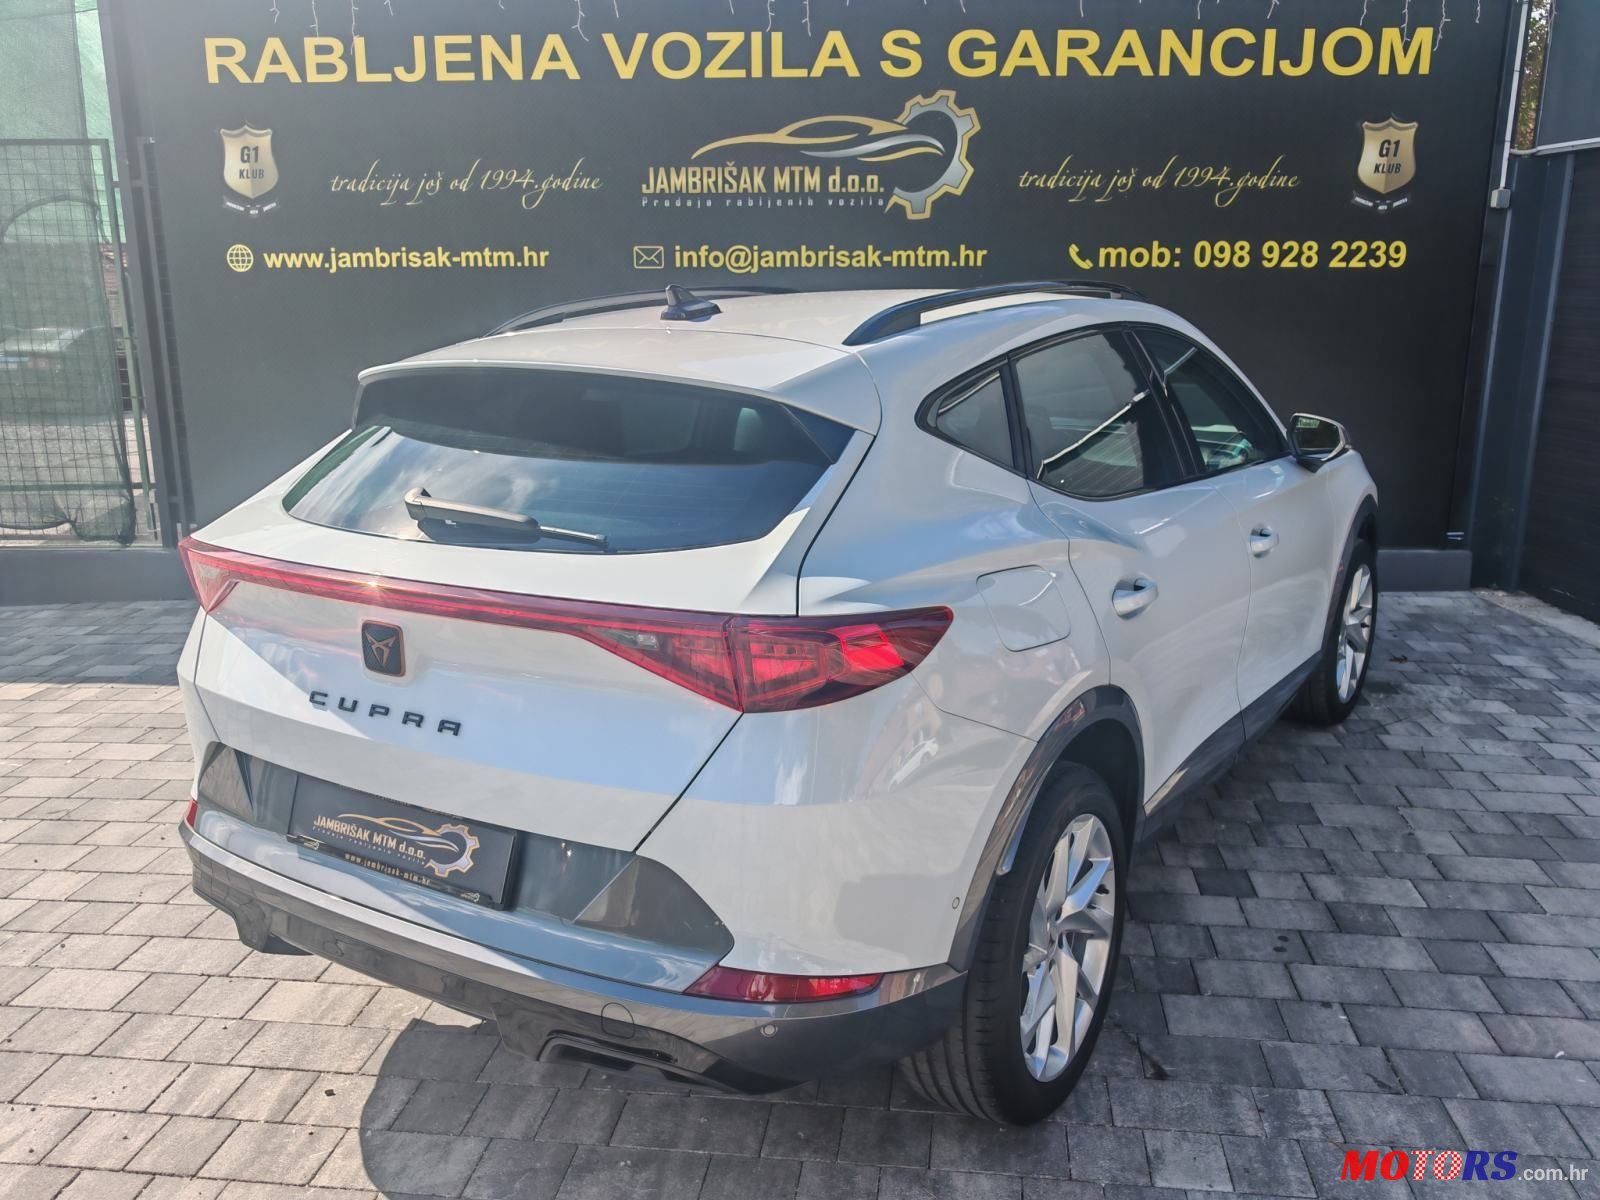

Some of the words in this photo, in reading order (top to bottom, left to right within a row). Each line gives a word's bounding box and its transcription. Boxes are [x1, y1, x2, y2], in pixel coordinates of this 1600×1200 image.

[204, 33, 581, 84] RABLJENA
[602, 30, 860, 80] VOZILA
[879, 29, 922, 78] S
[947, 27, 1434, 78] GARANCIJOM
[240, 145, 259, 164] G1
[1378, 139, 1401, 158] G1
[239, 168, 265, 180] KLUB
[330, 159, 411, 206] tradicija
[405, 171, 444, 206] još
[449, 158, 482, 193] od
[641, 161, 767, 194] JAMBRIŠAK
[774, 166, 821, 193] MTM
[828, 166, 885, 193] d.o.o.
[1018, 155, 1102, 202] tradicija
[1095, 167, 1139, 203] još
[1142, 154, 1179, 189] od
[1373, 163, 1402, 175] KLUB
[263, 246, 550, 274] www.jambrisak-mtm.hr
[674, 244, 988, 274] info@jambrisak-mtm.hr
[1098, 240, 1181, 269] mob:
[1194, 240, 1251, 268] 098
[1262, 240, 1319, 268] 928
[1329, 240, 1408, 268] 2239
[308, 690, 462, 737] CUPRA
[313, 815, 371, 842] JAMBRIŠAK
[372, 831, 397, 850] MTM
[399, 840, 427, 860] d.o.o.
